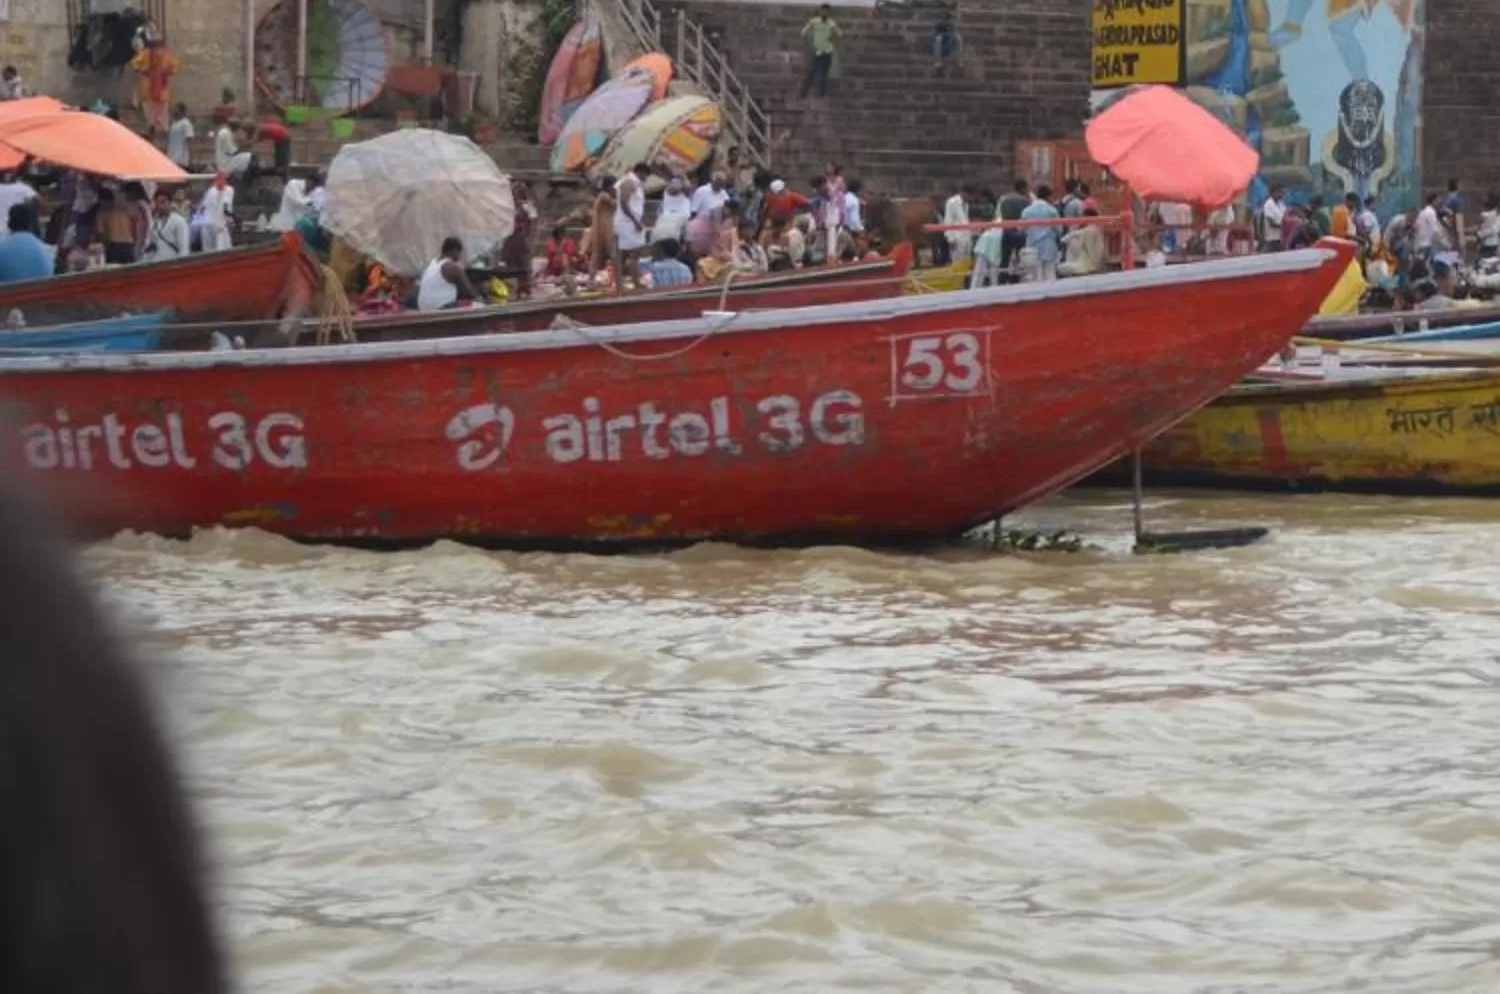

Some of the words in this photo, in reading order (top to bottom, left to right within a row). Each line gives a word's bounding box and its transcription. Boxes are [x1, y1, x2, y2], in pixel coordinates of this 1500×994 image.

[901, 332, 981, 392] 53
[24, 411, 196, 469] airtel
[209, 412, 307, 470] 3G
[545, 398, 742, 464] airtel
[758, 389, 863, 449] 3G
